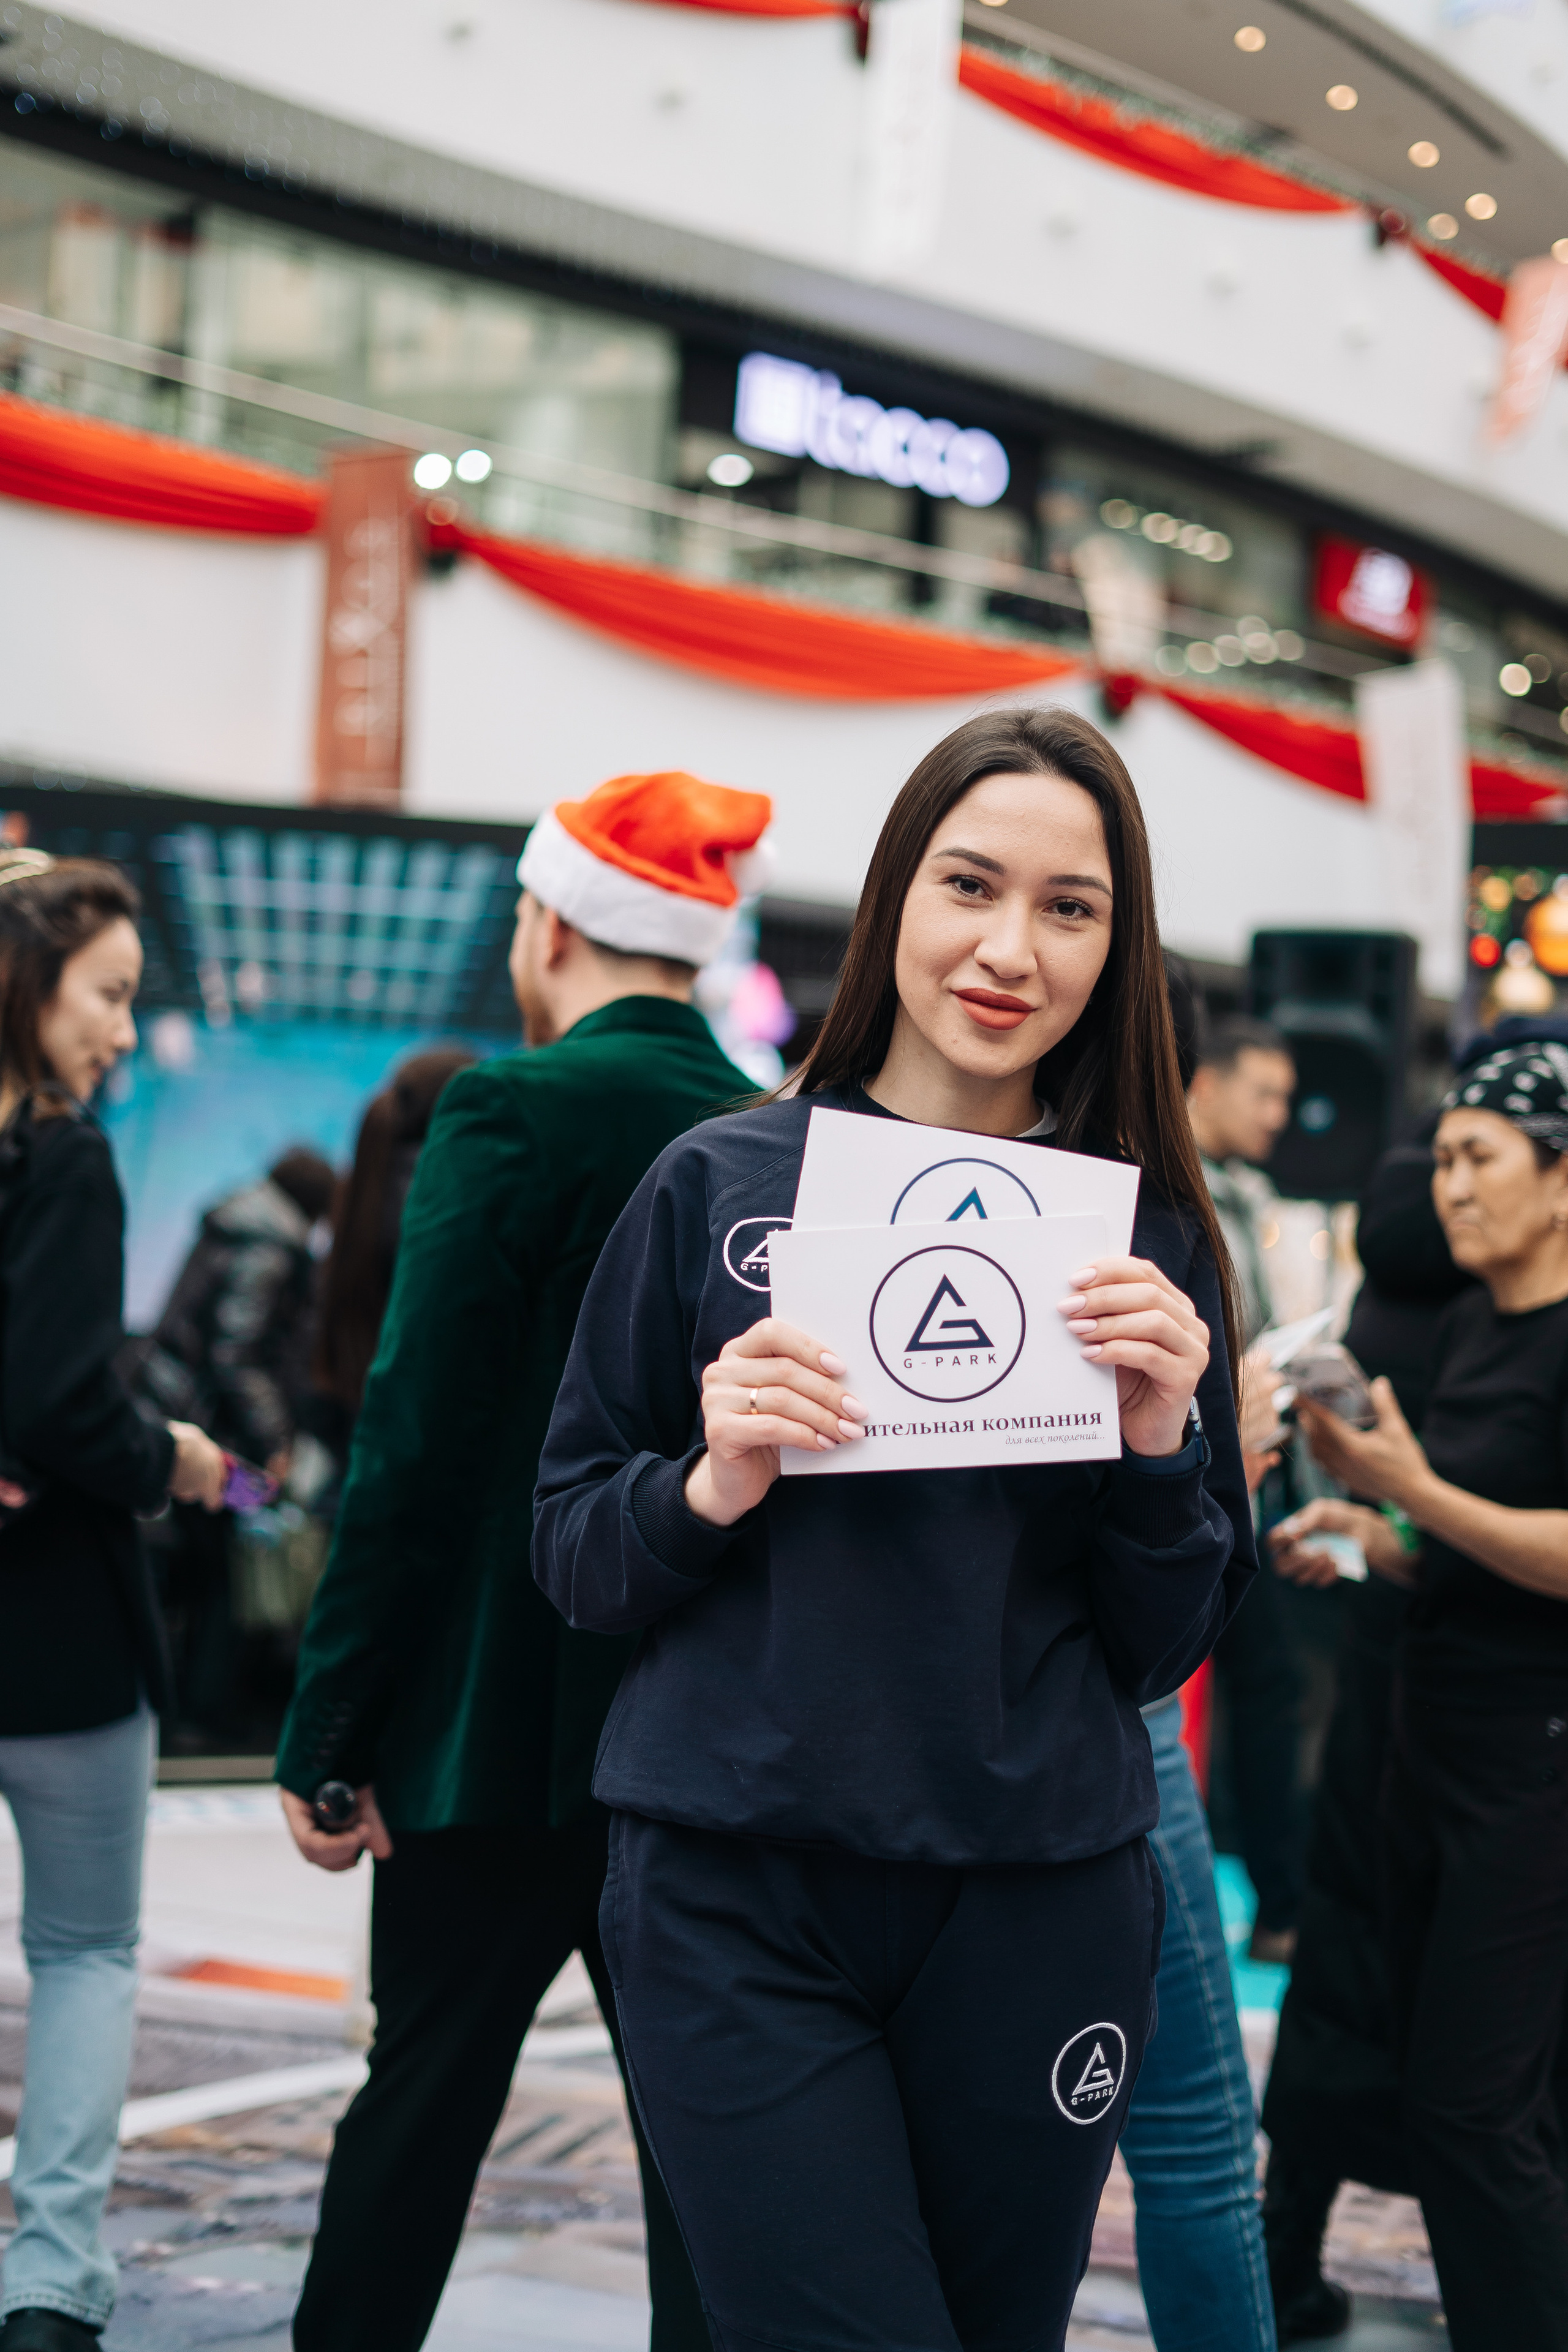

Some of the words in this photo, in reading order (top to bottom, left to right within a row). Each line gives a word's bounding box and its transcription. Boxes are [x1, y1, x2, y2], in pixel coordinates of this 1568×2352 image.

[741, 1262, 768, 1272] G-P
[903, 1353, 997, 1369] G-PARK
[862, 1419, 975, 1438] ительная
[981, 1412, 1102, 1431] компания
[1005, 1434, 1022, 1445] для
[1025, 1434, 1046, 1445] всех
[1071, 2086, 1114, 2106] G-PARK
